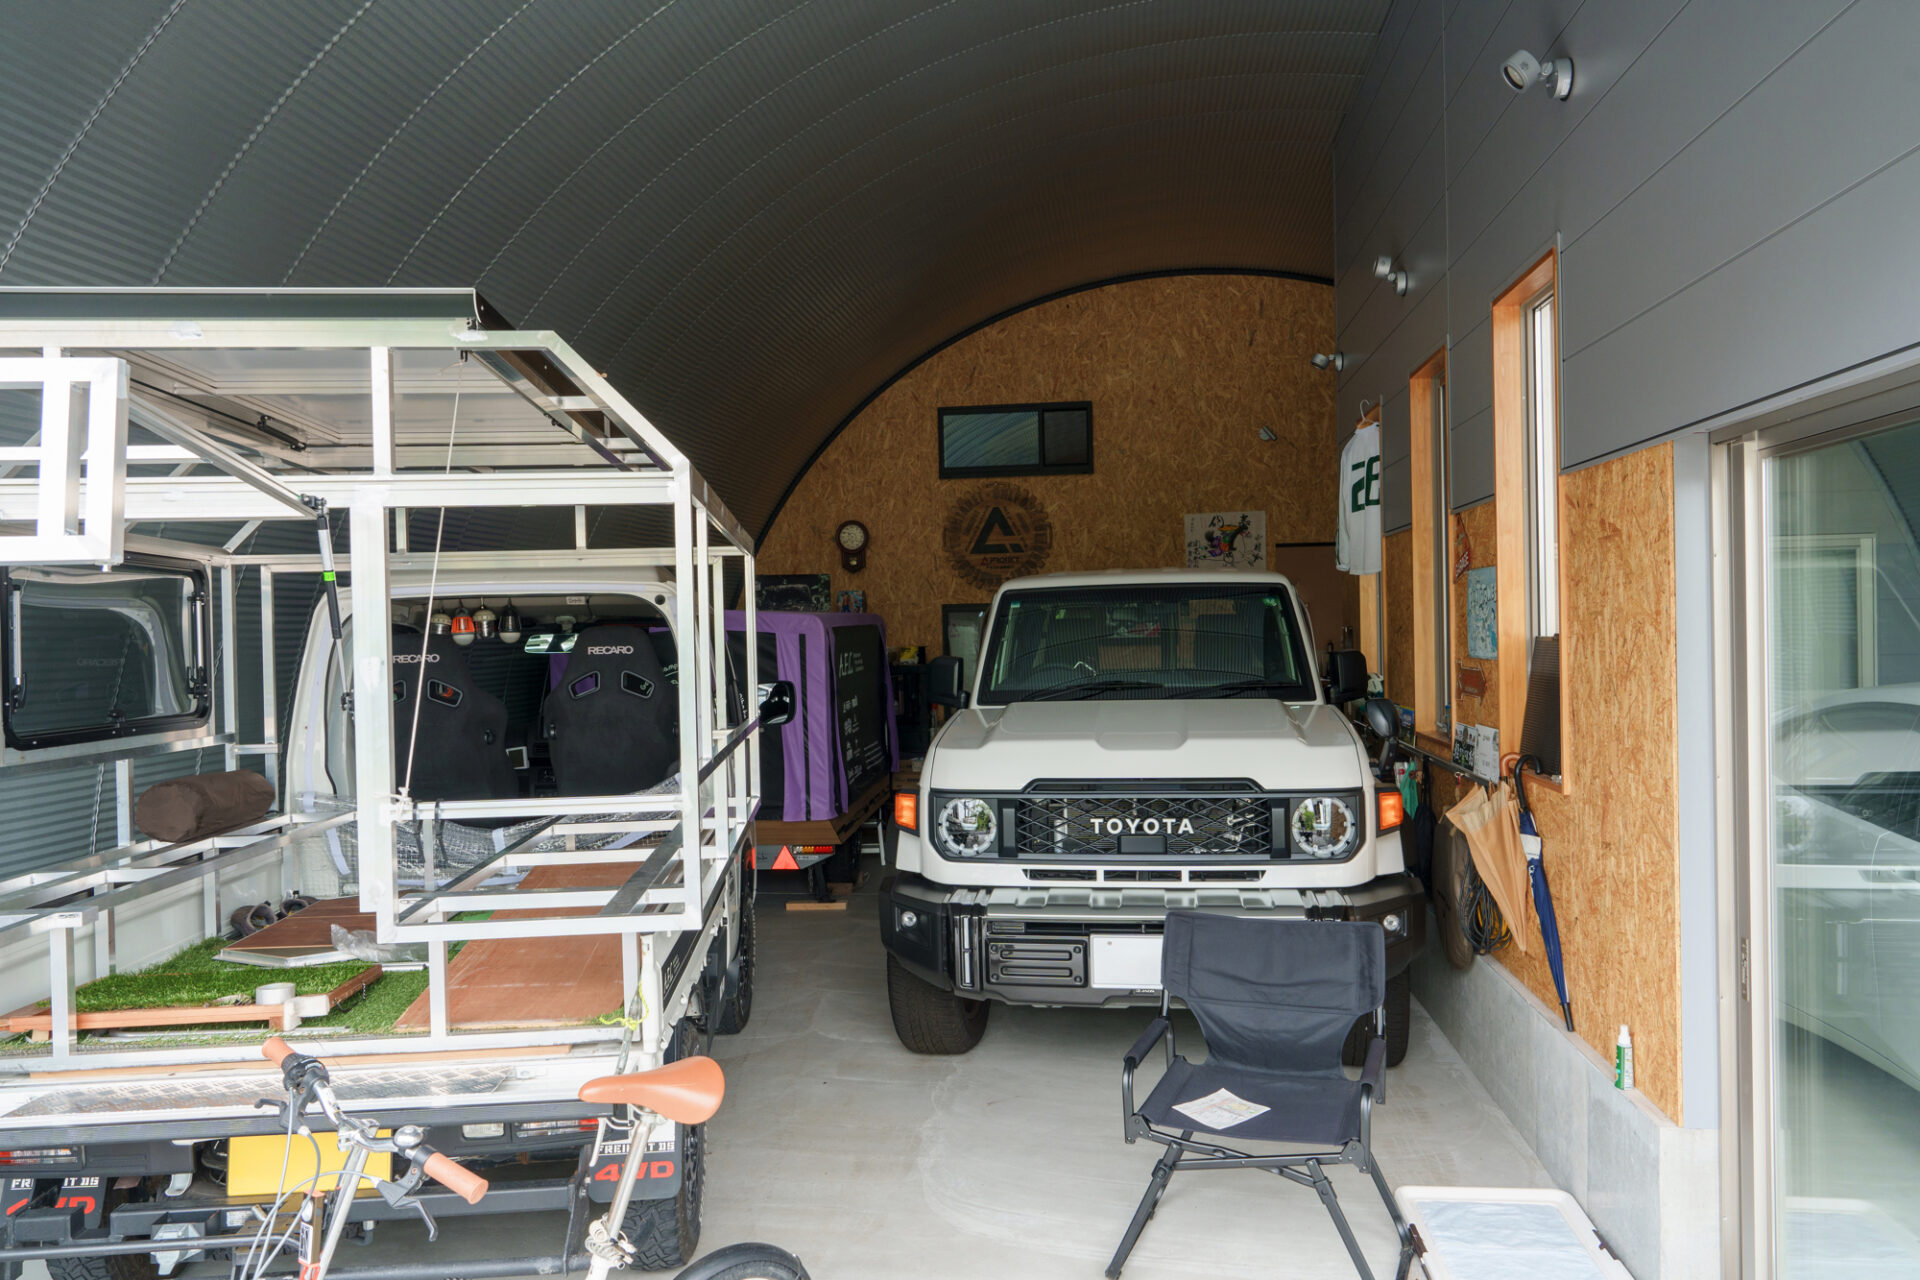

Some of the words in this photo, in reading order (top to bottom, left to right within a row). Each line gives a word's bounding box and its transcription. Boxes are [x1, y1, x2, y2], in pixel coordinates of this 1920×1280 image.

[587, 646, 634, 655] RECARO
[393, 654, 440, 663] RECARO
[1090, 818, 1194, 834] TOYOTA
